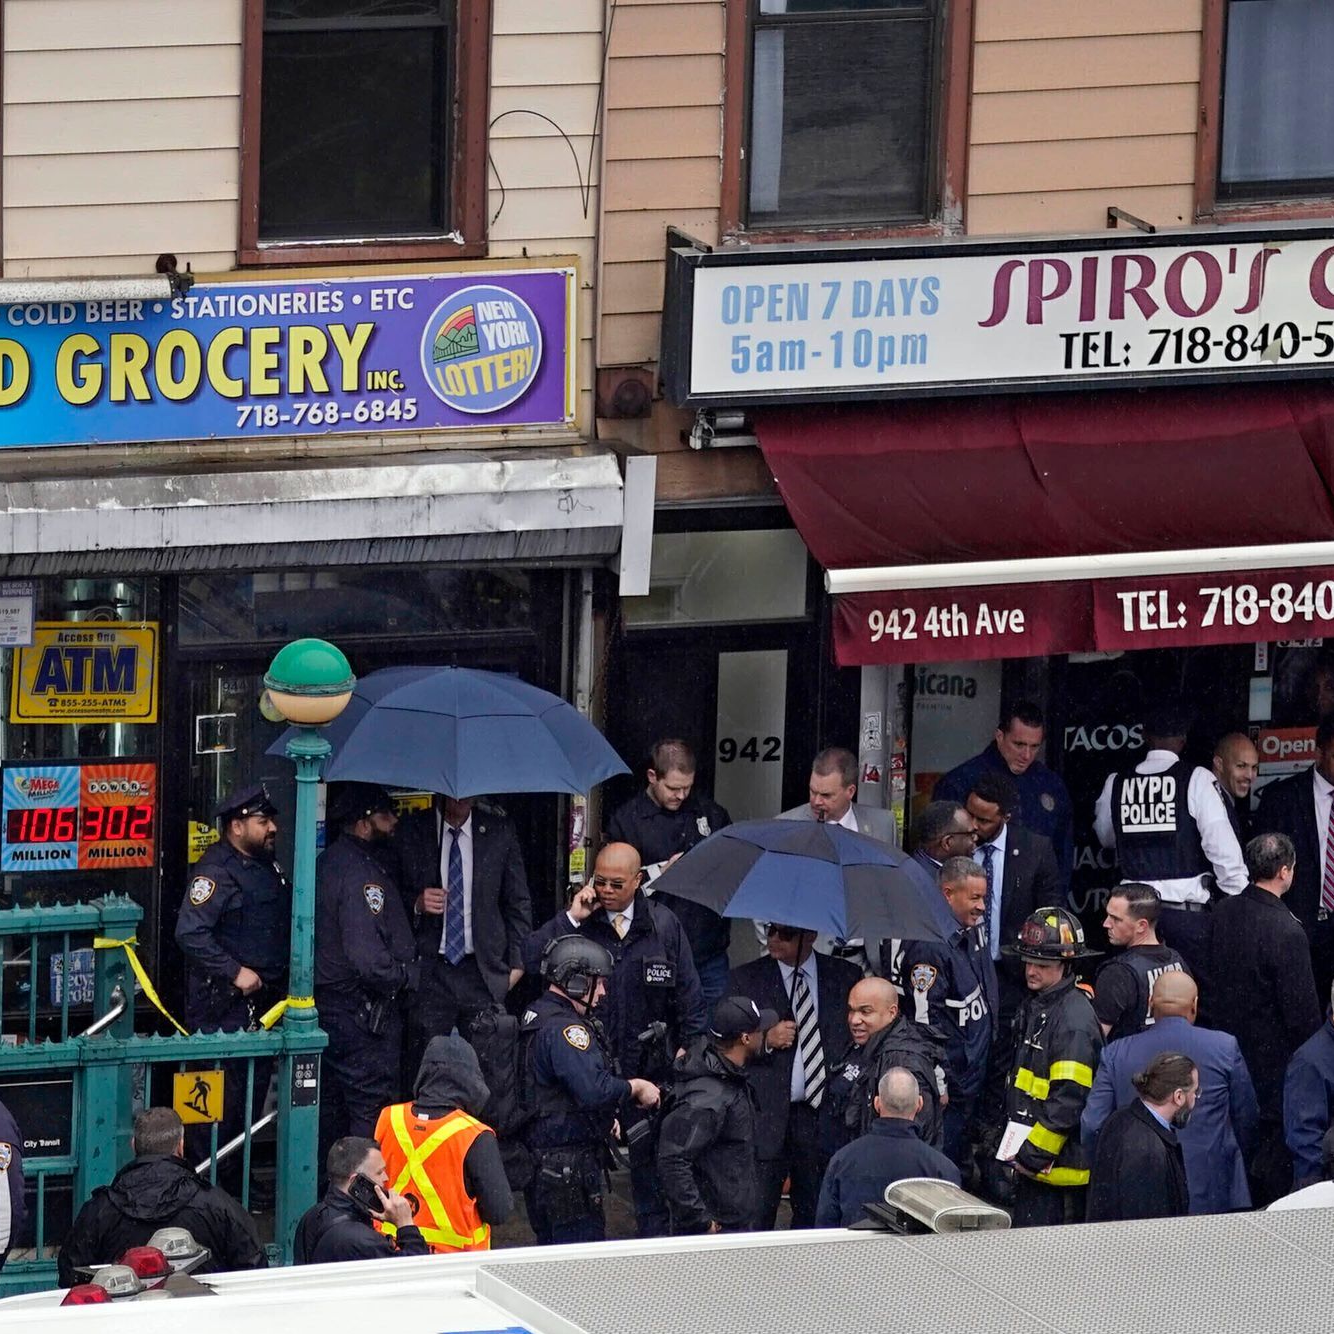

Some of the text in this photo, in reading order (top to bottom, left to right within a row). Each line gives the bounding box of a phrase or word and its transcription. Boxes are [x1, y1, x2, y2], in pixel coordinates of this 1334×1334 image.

[721, 276, 941, 325] OPEN 7 DAYS
[978, 242, 1282, 328] SPIRO'S
[7, 302, 76, 326] COLD
[85, 299, 145, 323] BEER
[171, 289, 345, 320] STATIONERIES
[369, 288, 415, 312] ETC
[476, 300, 515, 322] NEW
[480, 318, 530, 352] YORK
[730, 328, 928, 374] 5am-10pm
[1060, 330, 1132, 370] TEL:
[55, 322, 376, 406] GROCERY
[366, 369, 406, 392] INC.
[434, 345, 535, 398] LOTTERY
[236, 398, 418, 429] 718-768-6845
[867, 603, 1025, 642] 942 4th Ave
[1116, 590, 1187, 633] TEL:
[58, 632, 94, 643] Access
[30, 645, 139, 695] ATM
[718, 735, 781, 763] 942
[1064, 722, 1146, 751] TACOS
[1262, 736, 1317, 758] Open
[29, 779, 60, 791] MEGA
[1121, 776, 1176, 804] NYPD
[19, 806, 76, 842] 106
[82, 806, 152, 840] 302
[1120, 803, 1177, 826] POLICE
[11, 849, 71, 862] MILLION
[88, 846, 147, 859] MILLION
[647, 969, 671, 978] POLICE
[23, 1138, 62, 1150] City Transit
